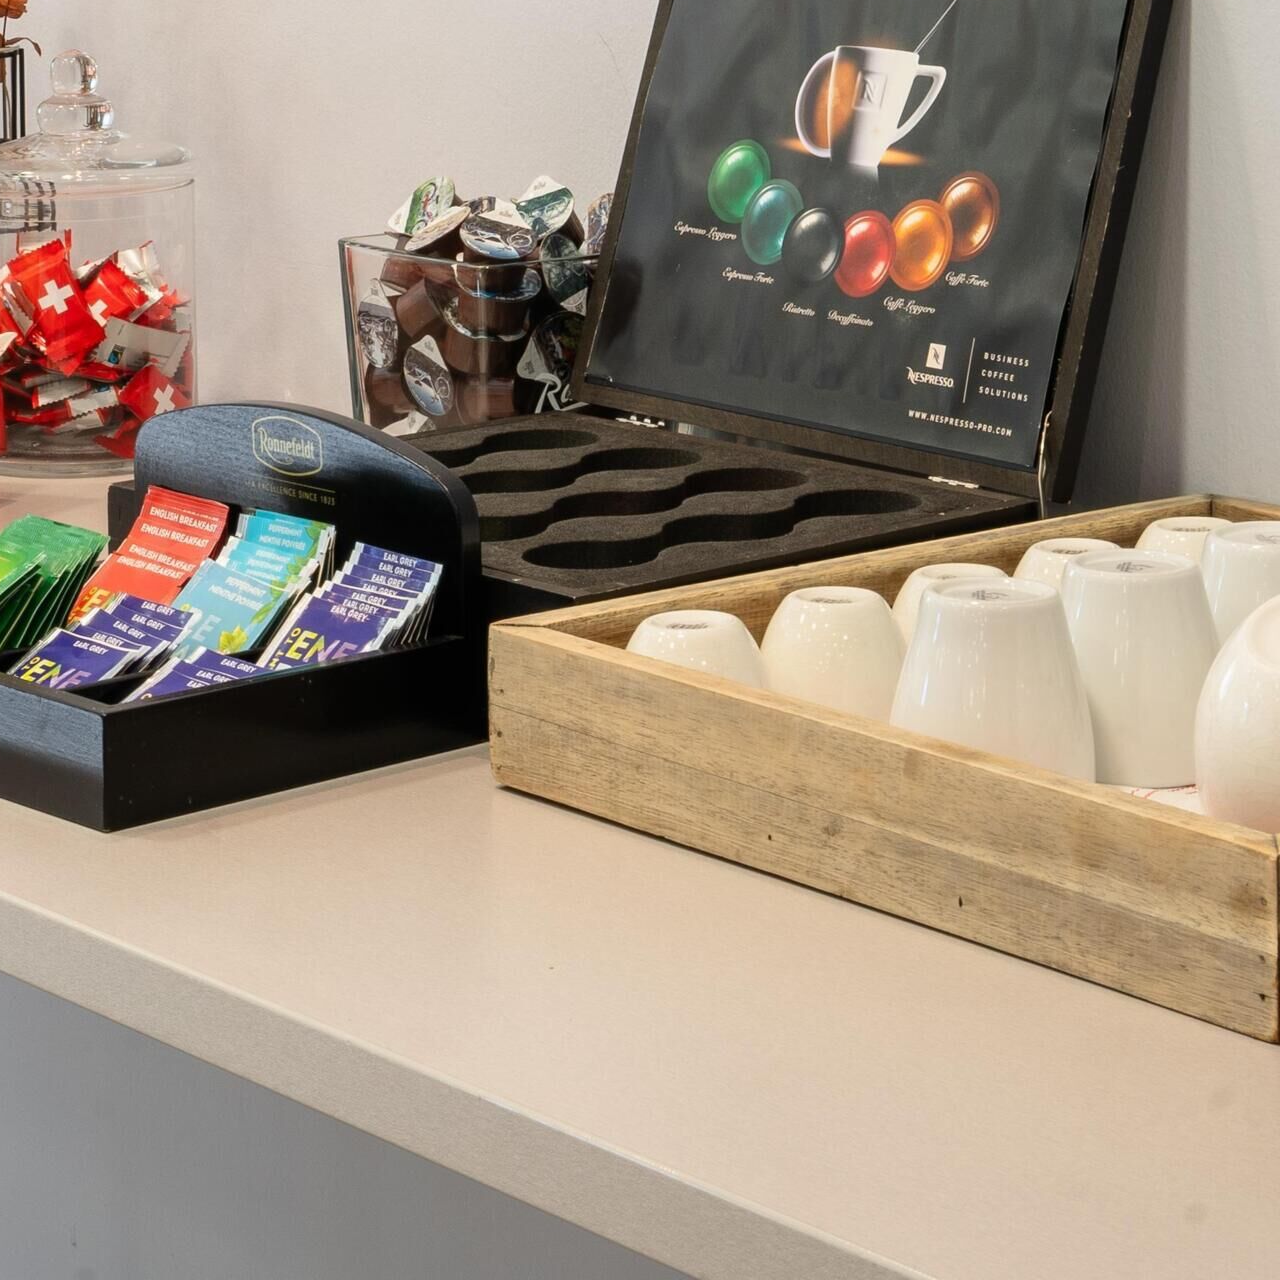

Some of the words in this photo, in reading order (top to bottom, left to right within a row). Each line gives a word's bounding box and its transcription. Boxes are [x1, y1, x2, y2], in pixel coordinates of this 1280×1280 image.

[674, 221, 706, 235] Espresso
[706, 227, 737, 241] Leggero
[722, 267, 753, 281] Espresso
[754, 272, 775, 284] Forte
[966, 275, 989, 288] Forte
[782, 302, 815, 317] Ristretto
[903, 300, 936, 315] Leggero
[827, 310, 873, 326] Decaffeinato
[983, 352, 1029, 367] BUSINESS
[906, 366, 954, 388] NESPRESSO
[981, 369, 1015, 382] COFFEE
[978, 386, 1029, 402] SOLUTIONS
[908, 409, 1012, 437] WWW.NESPRESSO-PRO.COM
[257, 427, 315, 465] Ronnefeldt
[149, 506, 179, 523] ENGLISH
[178, 514, 218, 533] BREAKFAST
[140, 523, 170, 538] ENGLISH
[170, 531, 209, 549] BREAKFAST
[128, 544, 159, 561] ENGLISH
[158, 553, 197, 572] BREAKFAST
[383, 553, 399, 563] EARL
[399, 556, 418, 567] GREY
[116, 556, 146, 571] ENGLISH
[144, 564, 186, 580] BREAKFAST
[378, 562, 394, 573] EARL
[394, 567, 413, 578] GREY
[371, 573, 387, 583] EARL
[387, 577, 406, 588] GREY
[343, 599, 360, 610] EARL
[360, 603, 379, 615] GREY
[351, 592, 368, 602] EARL
[368, 595, 387, 606] GREY
[141, 601, 157, 611] EARL
[156, 605, 175, 616] GREY
[330, 606, 347, 616] EARL
[347, 610, 369, 622] GREY
[113, 621, 128, 632] EARL
[127, 627, 146, 639] GREY
[131, 614, 147, 624] EARL
[146, 618, 165, 630] GREY
[73, 640, 89, 650] EARL
[89, 644, 109, 655] GREY
[221, 658, 237, 669] EARL
[237, 663, 257, 673] GREY
[196, 670, 213, 680] EARL
